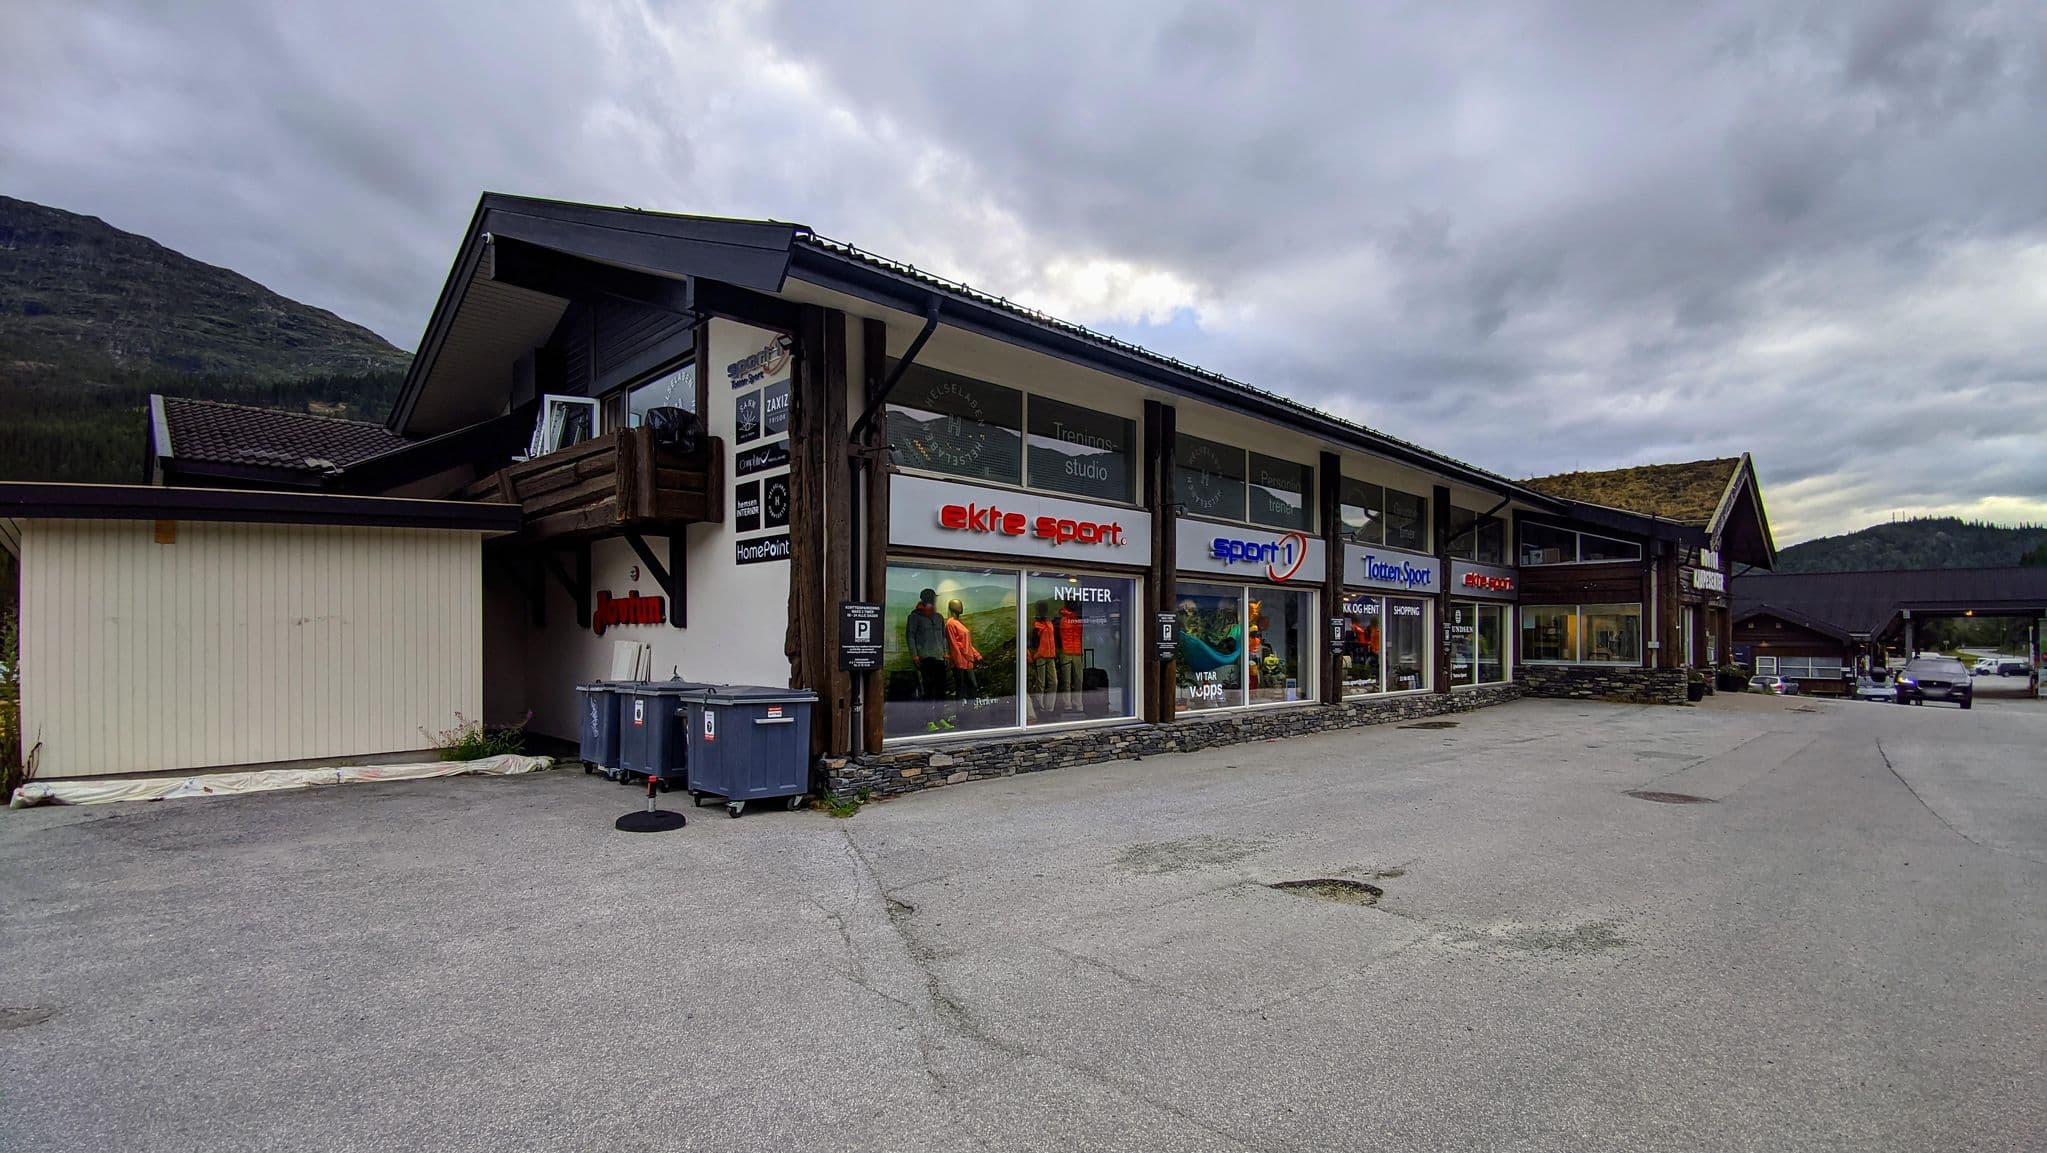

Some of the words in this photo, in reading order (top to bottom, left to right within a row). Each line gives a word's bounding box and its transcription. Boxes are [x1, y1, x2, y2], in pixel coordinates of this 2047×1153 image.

[1065, 458, 1108, 481] studio
[940, 502, 1026, 536] ekte
[737, 540, 790, 560] HomePoint
[1213, 537, 1279, 565] sport
[1285, 543, 1293, 565] 1
[1365, 555, 1401, 582] Totten
[1403, 560, 1432, 588] Sport
[1464, 572, 1487, 588] ekte
[1054, 586, 1112, 603] NYHETER
[1352, 603, 1363, 614] OG
[1364, 603, 1380, 615] HENT
[1393, 605, 1420, 616] SHOPPING
[858, 622, 868, 638] P
[1195, 672, 1203, 681] VI
[1203, 671, 1218, 681] TAR
